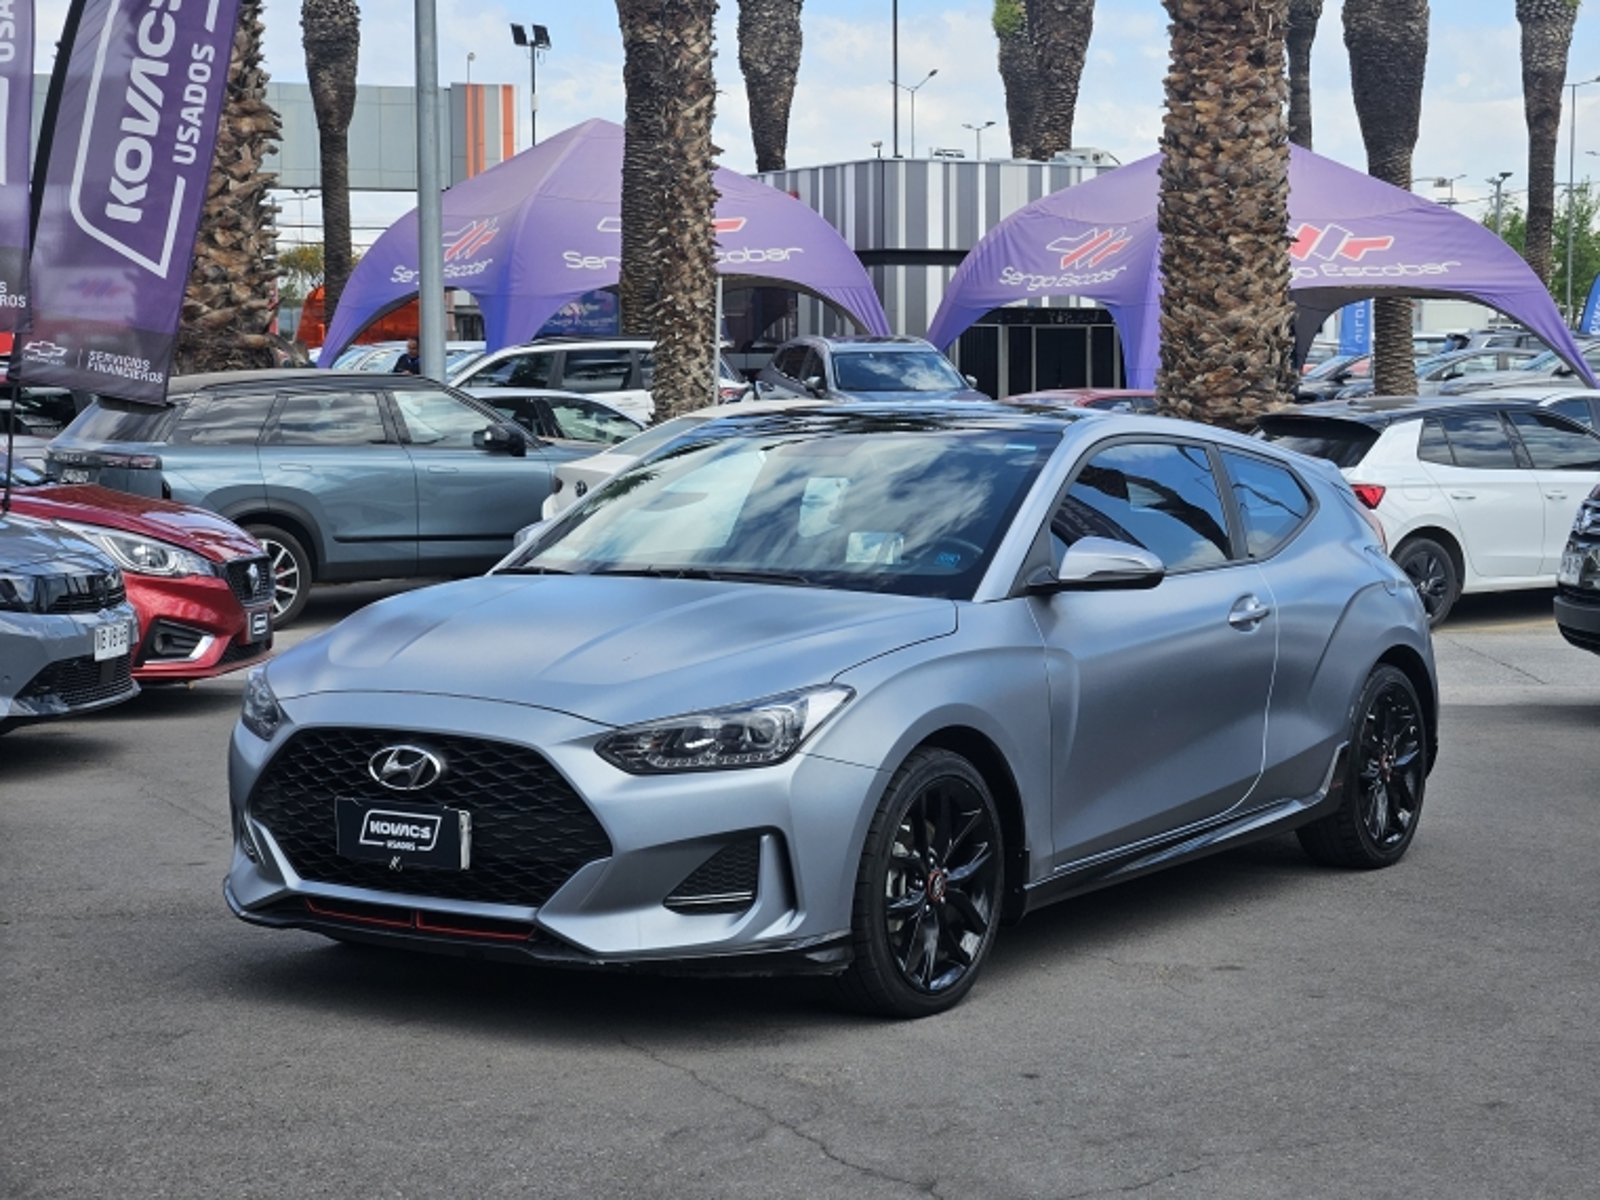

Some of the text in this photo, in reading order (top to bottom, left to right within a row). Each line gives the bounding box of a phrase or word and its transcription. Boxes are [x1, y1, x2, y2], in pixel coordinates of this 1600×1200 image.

[172, 43, 216, 166] USADOS
[562, 247, 804, 270] Ser cobar
[1320, 261, 1462, 278] Escobar
[390, 264, 420, 286] Ser
[88, 350, 151, 372] SERVICIOS
[86, 361, 164, 384] FINANCIEROS
[370, 820, 432, 839] KOVACS
